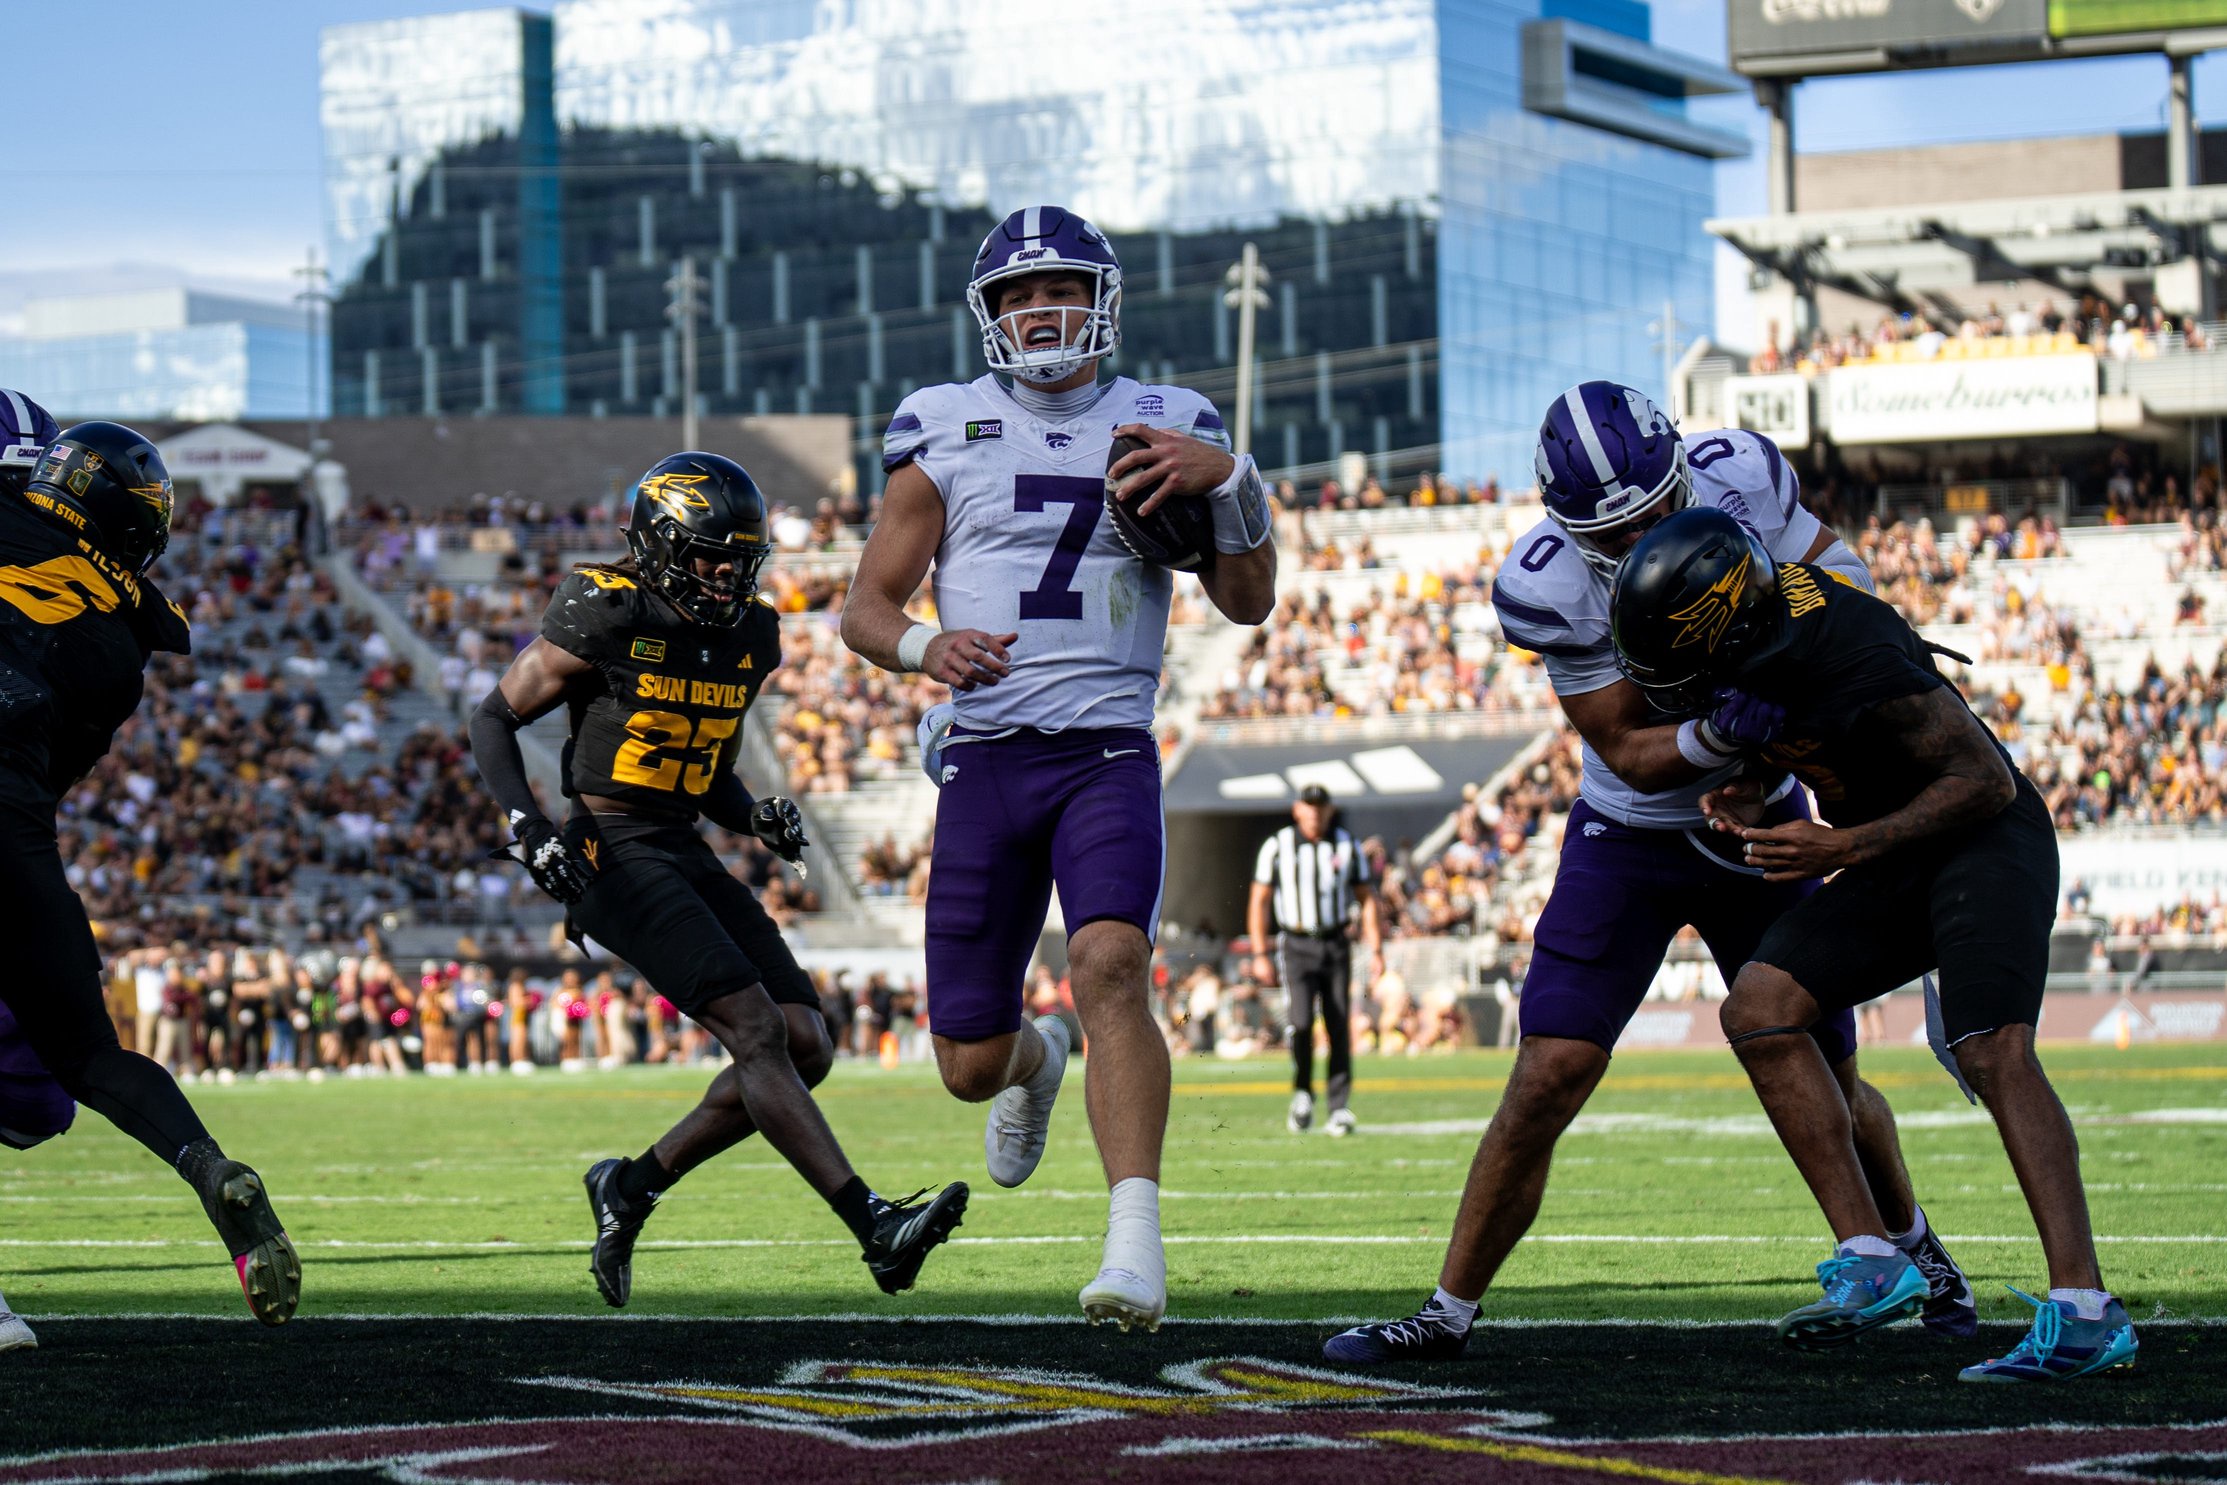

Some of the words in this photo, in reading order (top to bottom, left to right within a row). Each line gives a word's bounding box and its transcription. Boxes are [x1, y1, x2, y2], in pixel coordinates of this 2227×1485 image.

[1687, 438, 1735, 470] 0
[55, 503, 87, 531] STATE
[1014, 474, 1105, 620] 7
[1520, 534, 1565, 572] 0
[636, 673, 685, 702] SUN
[690, 680, 748, 709] DEVILS
